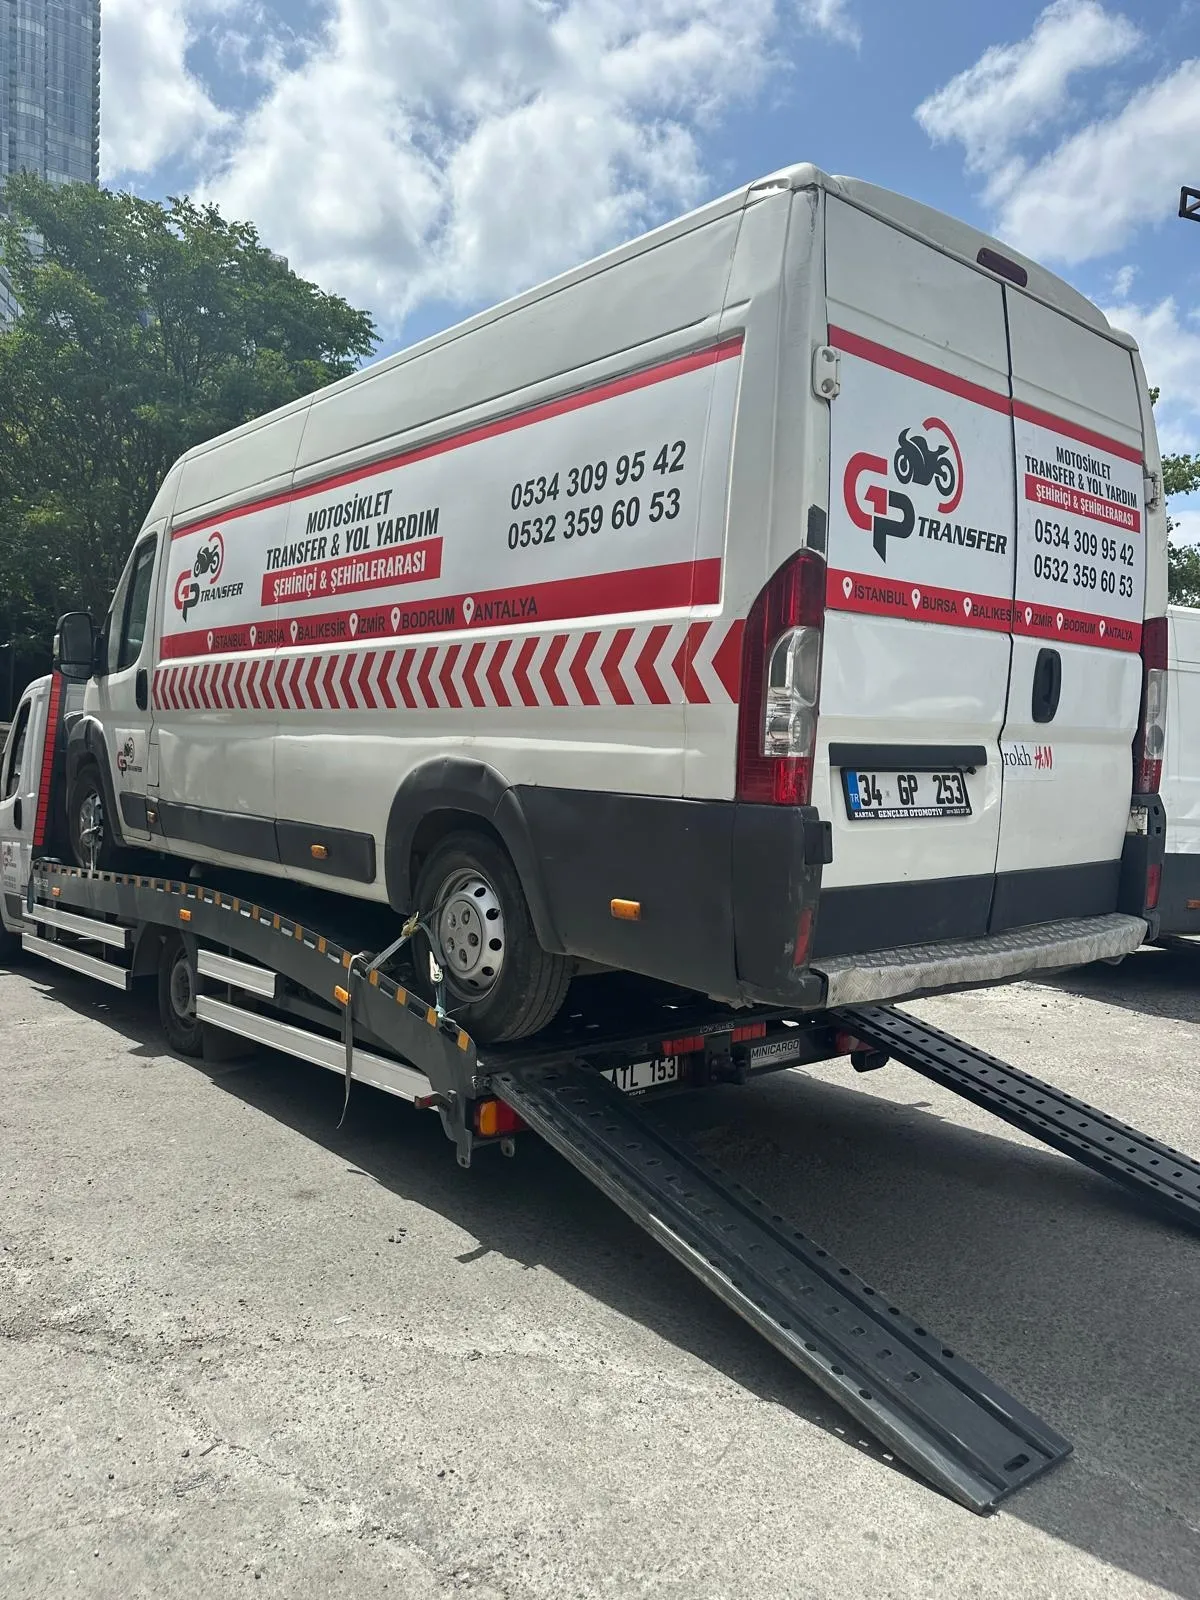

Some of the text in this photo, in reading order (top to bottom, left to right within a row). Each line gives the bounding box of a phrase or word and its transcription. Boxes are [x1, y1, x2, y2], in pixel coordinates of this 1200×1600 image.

[511, 440, 687, 510] 0534 309 95 42
[1025, 455, 1138, 509] TRANSFER & YOL YARDIM
[1056, 446, 1111, 480] MOTOSİKLET
[305, 489, 393, 535] MOTOSİKLET
[508, 487, 681, 550] 0532 359 60 53
[1036, 484, 1134, 527] ŞEHİRİÇİ & ŞEHİRLERARASI
[266, 507, 440, 571] TRANSFER & YOL YARDIM
[918, 516, 1008, 554] TRANSFER
[1035, 518, 1134, 567] 0534 309 95 42
[200, 582, 244, 602] TRANSFER
[273, 550, 427, 602] ŞEHİRİÇİ & ŞEHİRLERARASI
[1034, 554, 1133, 597] 0532 359 60 53
[257, 629, 285, 644] BURSA
[299, 618, 346, 640] BALIKESİR
[357, 612, 385, 634] İZMİR
[402, 608, 455, 629] BODRUM
[473, 596, 538, 621] ANTALYA
[854, 581, 908, 607] İSTANBUL
[922, 596, 958, 614] BURSA
[1064, 618, 1096, 634] BODRUM
[1104, 627, 1133, 640] ANTALYA
[1004, 745, 1032, 766] rokh
[850, 774, 964, 806] TR 34 GP 253
[878, 809, 909, 819] GENÇLER
[910, 808, 943, 817] OTOMOTİV
[649, 1056, 676, 1083] 153
[751, 1039, 800, 1059] MINICARGO
